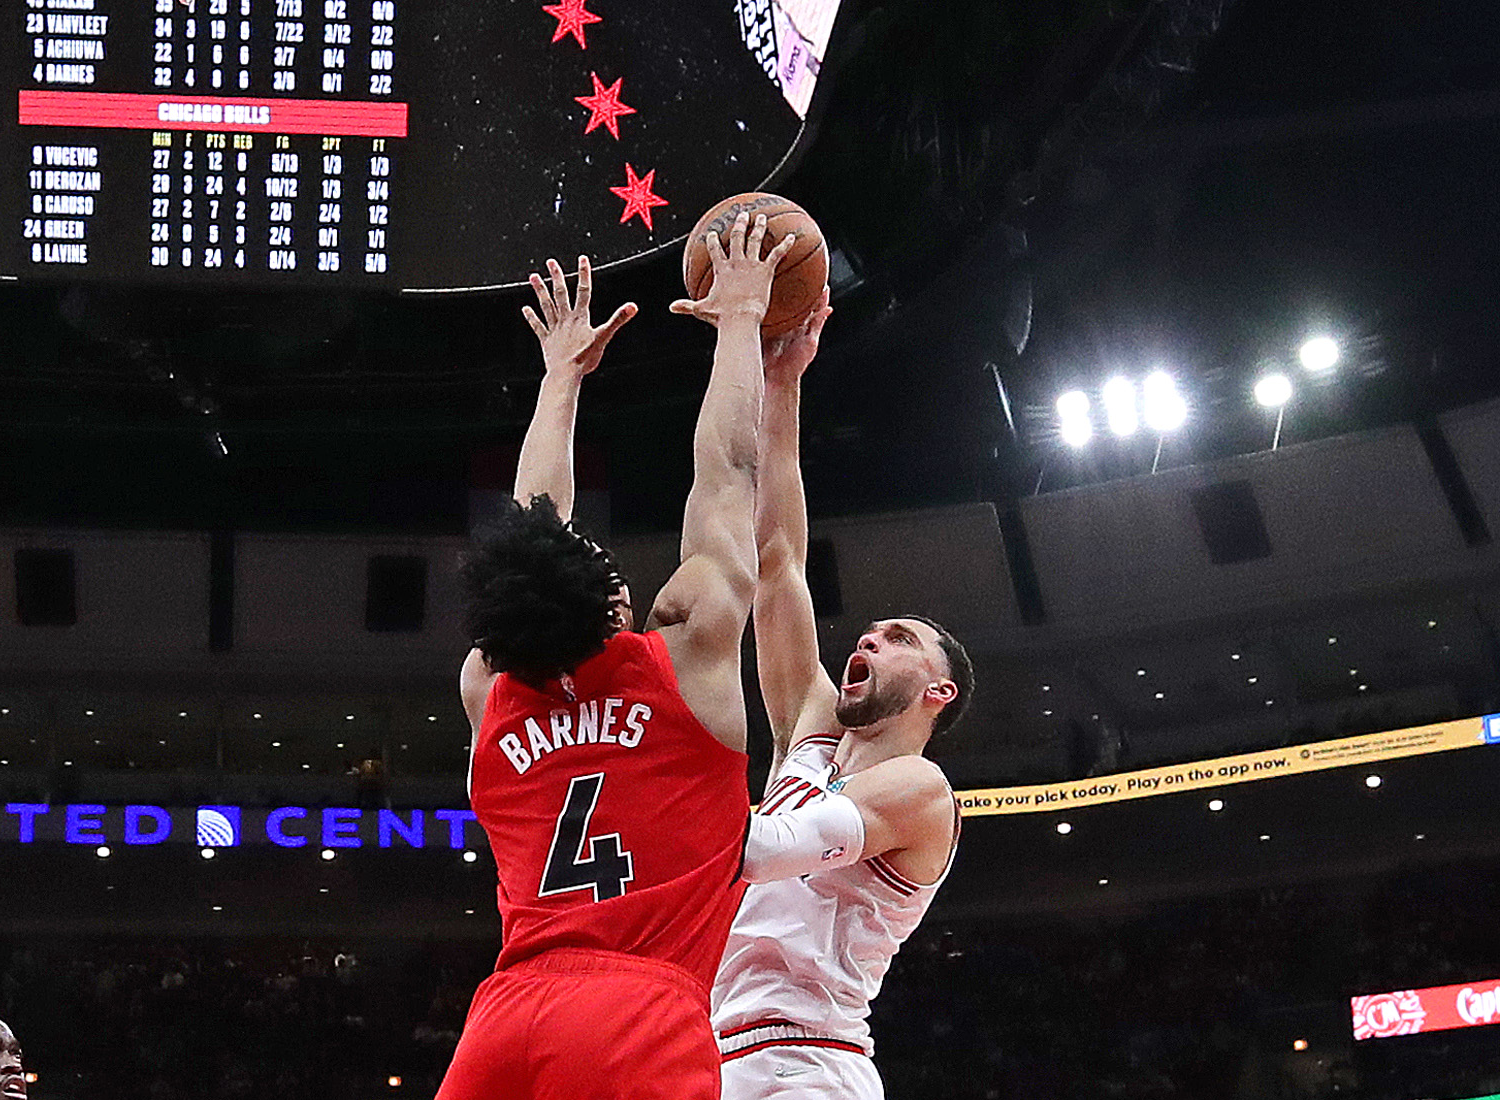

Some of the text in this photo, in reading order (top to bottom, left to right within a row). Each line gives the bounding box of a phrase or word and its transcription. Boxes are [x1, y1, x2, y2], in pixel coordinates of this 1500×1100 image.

[46, 14, 394, 46] VANVLEET 34 3 19 7/22 3/12 2/2
[34, 38, 345, 68] 5 ACHIUWA 22 1 6 3/7 0/4
[32, 63, 392, 94] 4 BARNES 32 4 0/1 2/2
[158, 102, 270, 125] CHICAGO BULLS
[206, 133, 385, 152] PTS FG 3PT FT
[45, 146, 390, 177] VUCEVIC 27 2 12 5/13 1/3 1/3
[29, 170, 389, 200] 11 DEROZAN 3 24 4 10/12 1/3 3/4
[45, 195, 388, 225] CARUSO 27 2 7 2 2/4 1/2
[23, 219, 385, 248] 24 GREEN 24 5 3 2/4 0/1 1/1
[44, 243, 340, 271] LAVINE 30 24 4 3/5
[499, 697, 653, 775] BARNES
[956, 756, 1292, 810] ake your pick today. Play on the app now.
[537, 771, 635, 904] 4
